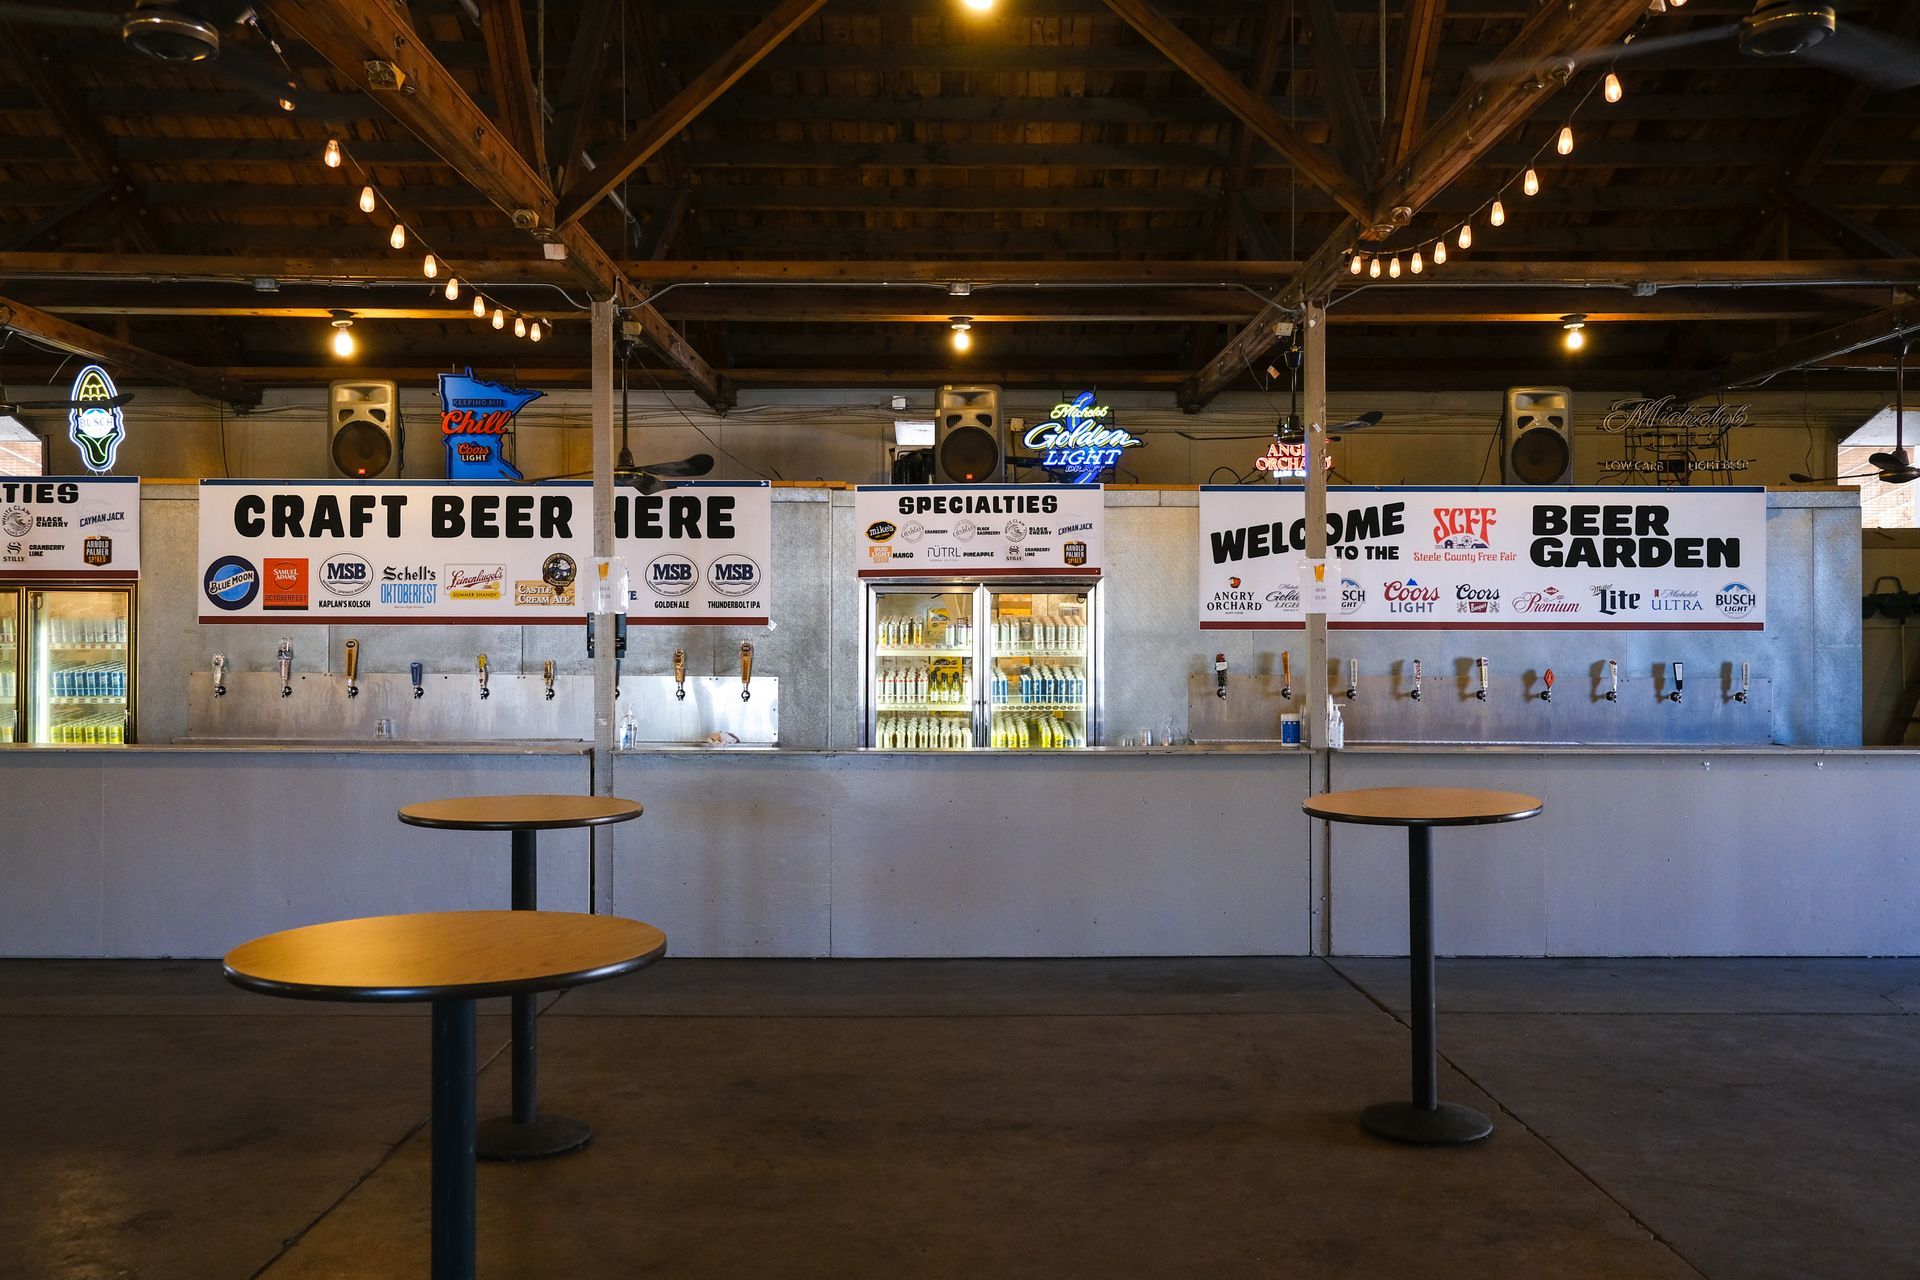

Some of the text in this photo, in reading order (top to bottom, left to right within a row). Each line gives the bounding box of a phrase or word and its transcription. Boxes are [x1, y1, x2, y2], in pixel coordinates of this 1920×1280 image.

[1050, 404, 1109, 419] Michelob
[80, 418, 112, 428] BUSCH
[441, 410, 512, 434] Chill
[1023, 419, 1142, 450] Golden
[458, 443, 489, 455] Coors
[1267, 444, 1306, 456] ANG
[1043, 450, 1122, 465] LIGHT
[0, 484, 79, 504] TIES
[13, 505, 31, 516] CLAW
[898, 495, 1058, 514] SPECIALTIES
[80, 512, 125, 528] CAYMAN JACK
[234, 494, 408, 538] CRAFT
[432, 495, 573, 538] BEER
[1532, 504, 1670, 536] BEER
[870, 525, 894, 536] mike's
[1058, 524, 1079, 535] CAYMAN
[1433, 508, 1497, 544] SCFF
[1334, 546, 1399, 560] TO THE
[1414, 552, 1518, 564] Steele County Free Fair
[1530, 537, 1740, 568] GARDEN
[328, 562, 366, 580] MSB
[381, 566, 436, 580] Schell's
[447, 566, 504, 590] Leinenkugel's
[653, 564, 692, 580] MSB
[715, 564, 754, 580] MSB
[210, 572, 253, 594] BLUE MOON
[518, 584, 552, 594] CASTLE
[1384, 580, 1440, 601] Coors
[380, 584, 438, 604] OKTOBERFEST
[518, 594, 570, 604] CREAM ALE
[1214, 592, 1254, 600] ANGRY
[1342, 590, 1365, 601] SCH
[1456, 584, 1500, 600] Coors
[1661, 589, 1698, 598] Michelob
[1716, 594, 1756, 605] BUSCH
[1206, 602, 1262, 610] ORCHARD
[1390, 602, 1434, 613] LIGHT
[1512, 592, 1580, 613] Premium
[1598, 590, 1640, 615] Lite
[1651, 600, 1703, 611] ULTRA
